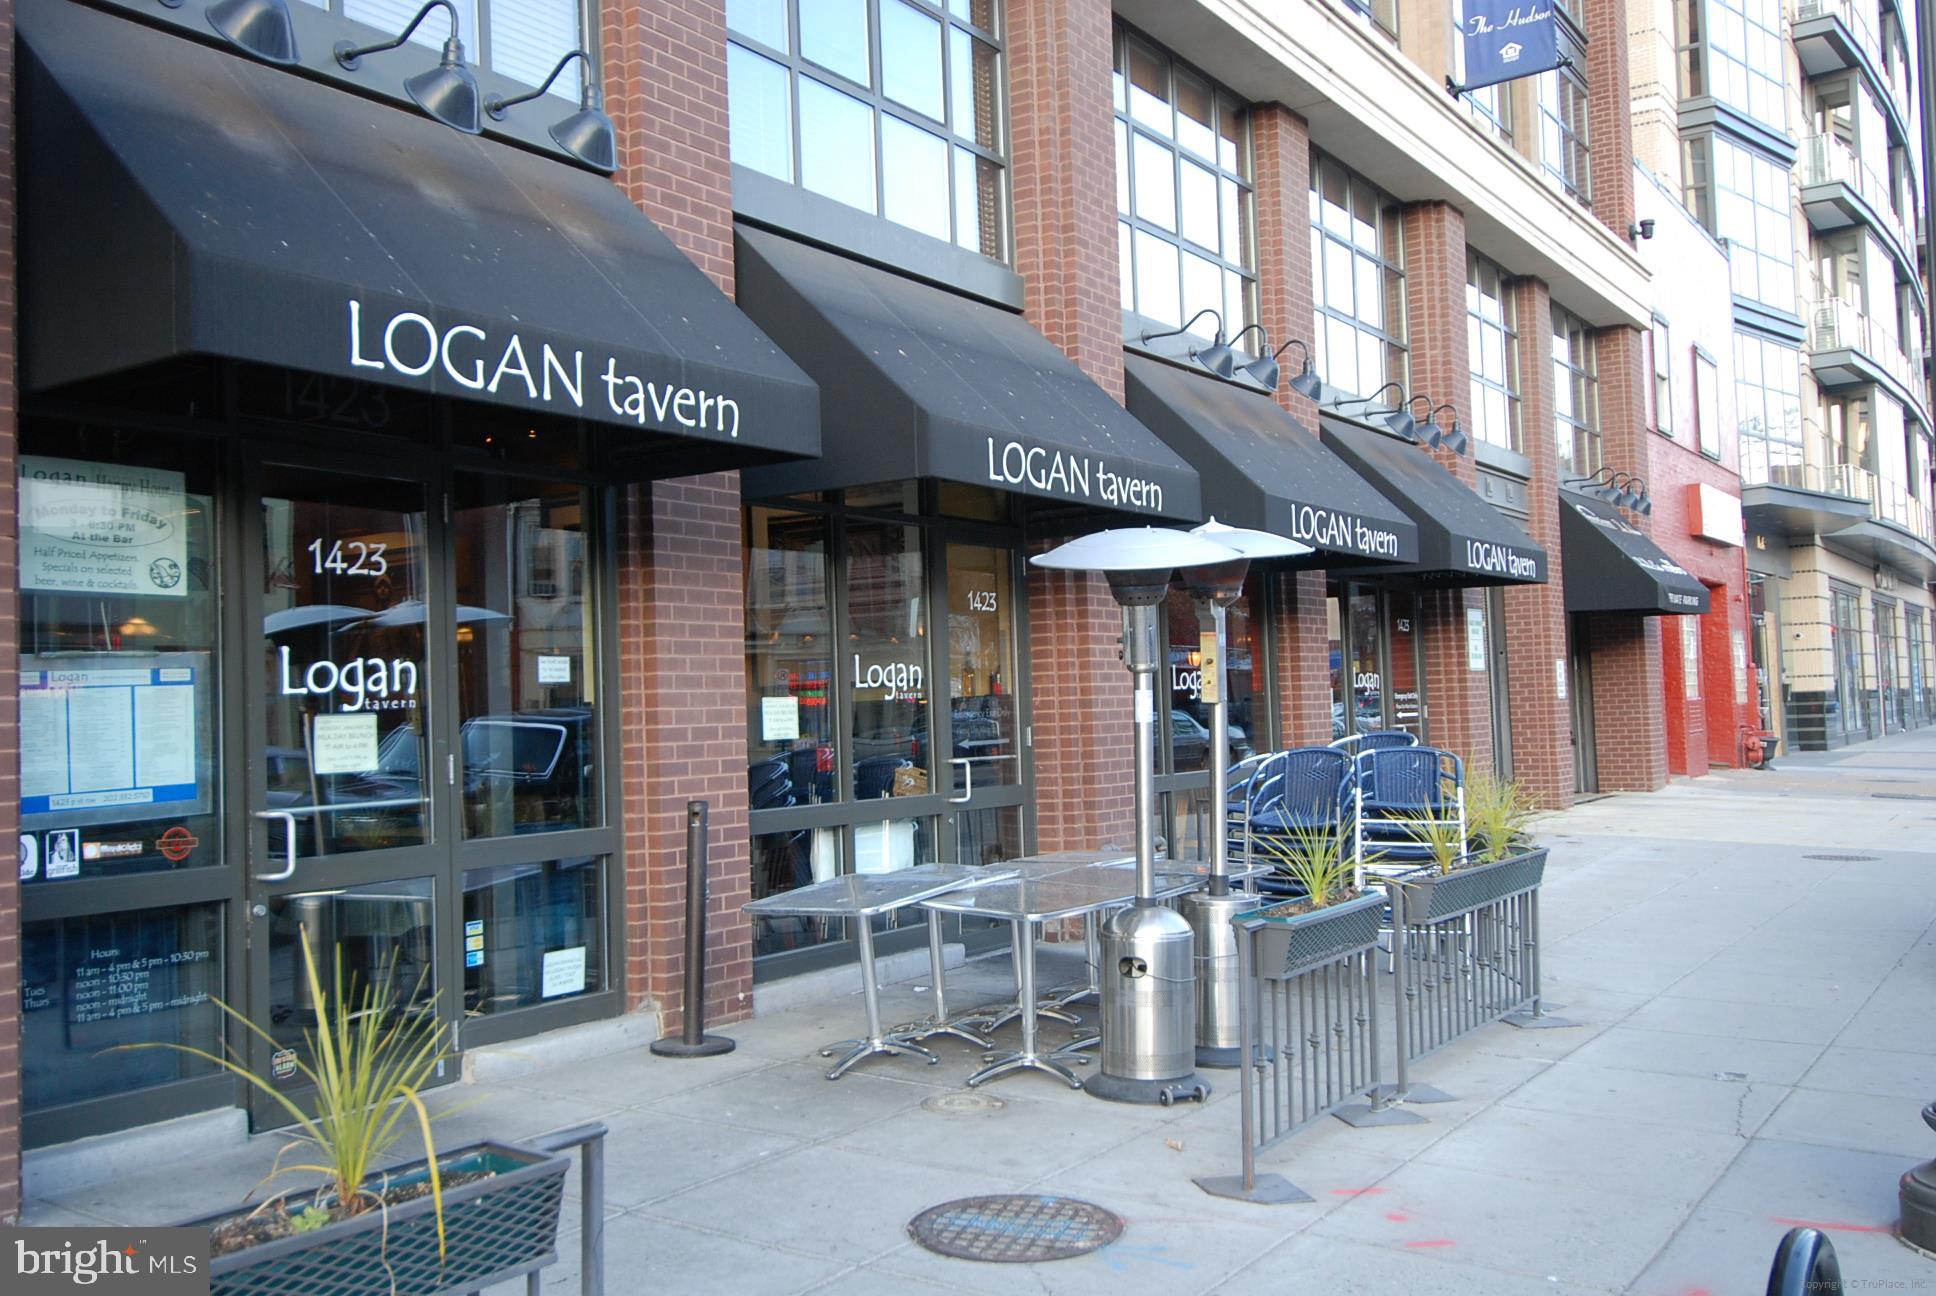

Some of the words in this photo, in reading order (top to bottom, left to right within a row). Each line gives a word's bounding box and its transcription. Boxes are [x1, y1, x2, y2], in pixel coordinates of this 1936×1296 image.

[1468, 16, 1493, 36] The
[1497, 5, 1551, 29] Hudson
[349, 300, 583, 407] LOGAN
[601, 357, 739, 437] tavern
[988, 437, 1090, 496] LOGAN
[1096, 461, 1162, 511] tavern
[102, 505, 117, 516] to
[121, 507, 167, 531] Friday
[118, 522, 136, 533] PM
[1291, 504, 1352, 547] LOGAN
[1355, 519, 1398, 556] tavern
[90, 532, 109, 542] the
[113, 533, 134, 544] Bar
[33, 546, 57, 558] Half
[57, 548, 86, 560] Priced
[308, 538, 388, 576] 1423
[1467, 540, 1507, 572] LOGAN
[1508, 549, 1536, 578] tavern
[42, 562, 78, 575] Specials
[96, 566, 132, 577] selected
[61, 578, 84, 588] wine
[86, 580, 95, 588] &
[967, 590, 997, 611] 1423
[51, 671, 88, 684] Logan
[281, 646, 417, 711] Logan
[855, 654, 922, 700] Logan
[1172, 664, 1201, 699] Loga
[1353, 667, 1379, 695] Logan
[365, 698, 417, 710] tavern
[896, 691, 922, 700] tavern
[87, 967, 100, 976] am
[108, 962, 114, 972] 4
[115, 962, 132, 974] pm
[132, 959, 141, 969] &
[142, 957, 147, 968] 5
[148, 957, 163, 969] pm
[195, 949, 209, 962] pm
[75, 979, 100, 989] noon
[135, 970, 150, 982] pm
[76, 990, 100, 1001] noon
[134, 981, 149, 994] pm
[76, 1002, 101, 1012] noon
[108, 990, 147, 1007] midnight
[87, 1013, 101, 1022] am
[108, 1008, 115, 1018] 4
[117, 1006, 131, 1019] pm
[132, 1002, 141, 1013] &
[142, 1001, 148, 1011] 5
[149, 1000, 163, 1013] pm
[170, 991, 208, 1007] midnight
